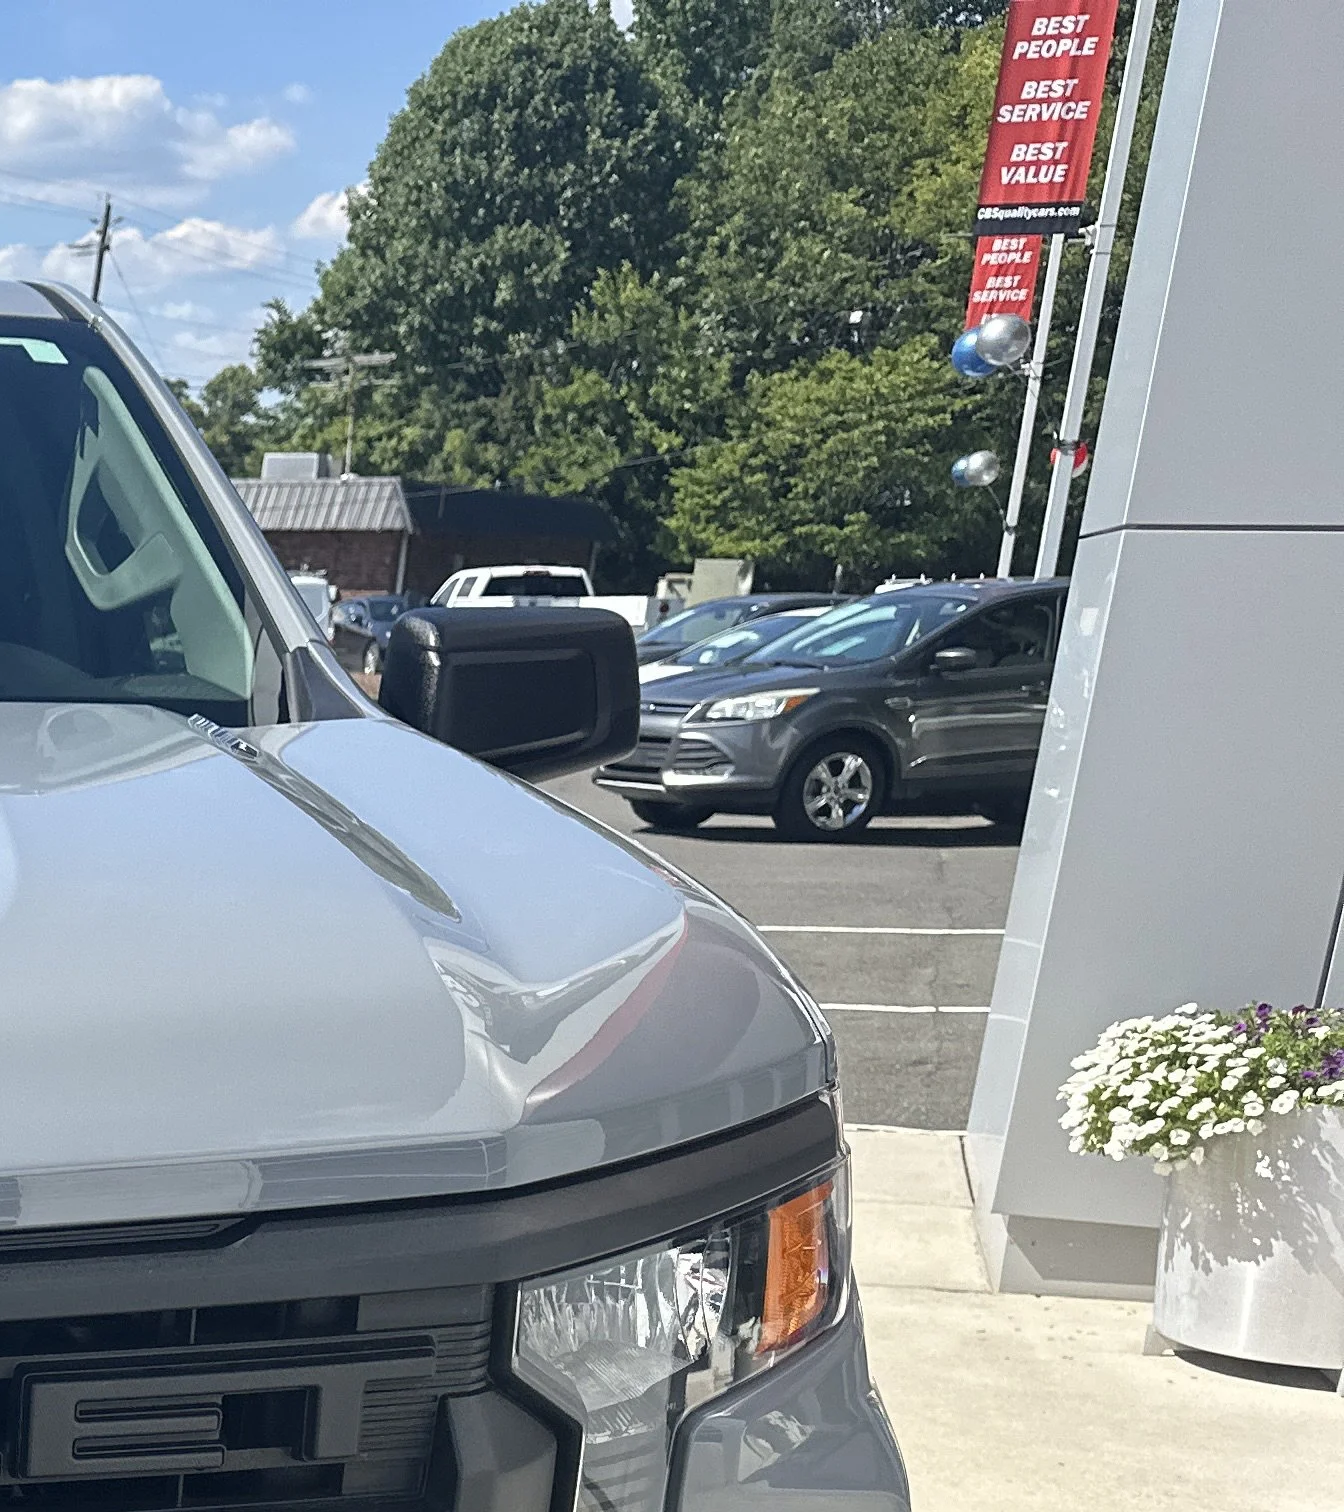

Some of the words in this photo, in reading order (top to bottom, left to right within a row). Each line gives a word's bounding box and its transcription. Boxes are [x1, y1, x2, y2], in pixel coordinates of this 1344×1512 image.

[1031, 14, 1091, 36] BEST
[1012, 37, 1099, 60] PEOPLE
[1020, 78, 1080, 100] BEST
[996, 101, 1092, 123] SERVICE
[1009, 141, 1069, 162] BEST
[1001, 164, 1069, 185] VALUE
[992, 237, 1028, 252] BEST
[980, 251, 1033, 266] PEOPLE
[985, 275, 1022, 290] BEST
[972, 288, 1029, 303] SERVICE
